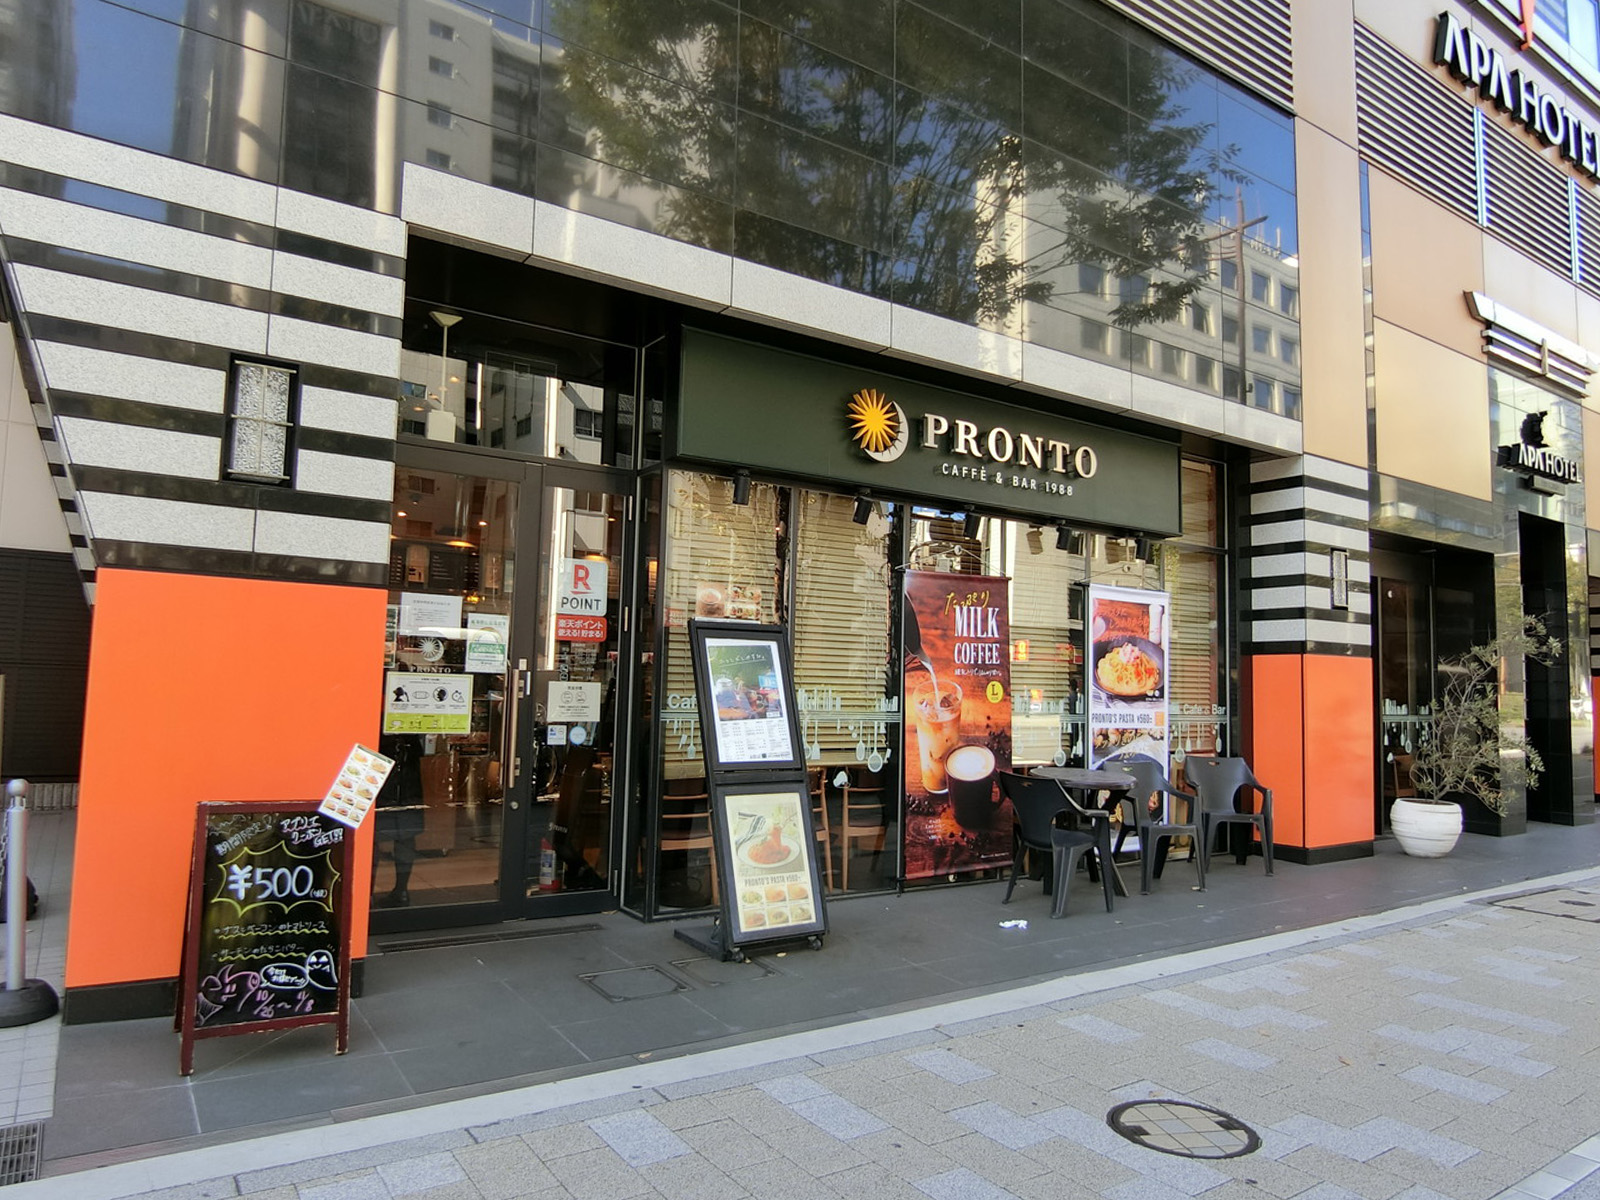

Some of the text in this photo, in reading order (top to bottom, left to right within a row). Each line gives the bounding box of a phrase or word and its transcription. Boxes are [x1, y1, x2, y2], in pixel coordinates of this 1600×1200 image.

[1436, 11, 1513, 113] APA
[923, 413, 1098, 479] PRONTO
[1518, 442, 1582, 483] APA HOTEL
[995, 472, 1003, 484] &
[1012, 475, 1037, 490] BAR
[1045, 481, 1073, 497] 1988
[573, 564, 592, 590] R
[561, 597, 601, 611] POINT
[557, 618, 603, 629] 楽天ポイント
[954, 605, 1000, 638] MILK
[954, 642, 1000, 665] COFFEE
[990, 684, 999, 696] L
[1091, 712, 1118, 724] PRONTO'S
[1119, 713, 1135, 724] PASTA
[1211, 703, 1226, 715] Bar
[228, 864, 313, 900] ¥500
[770, 874, 786, 884] PASTA
